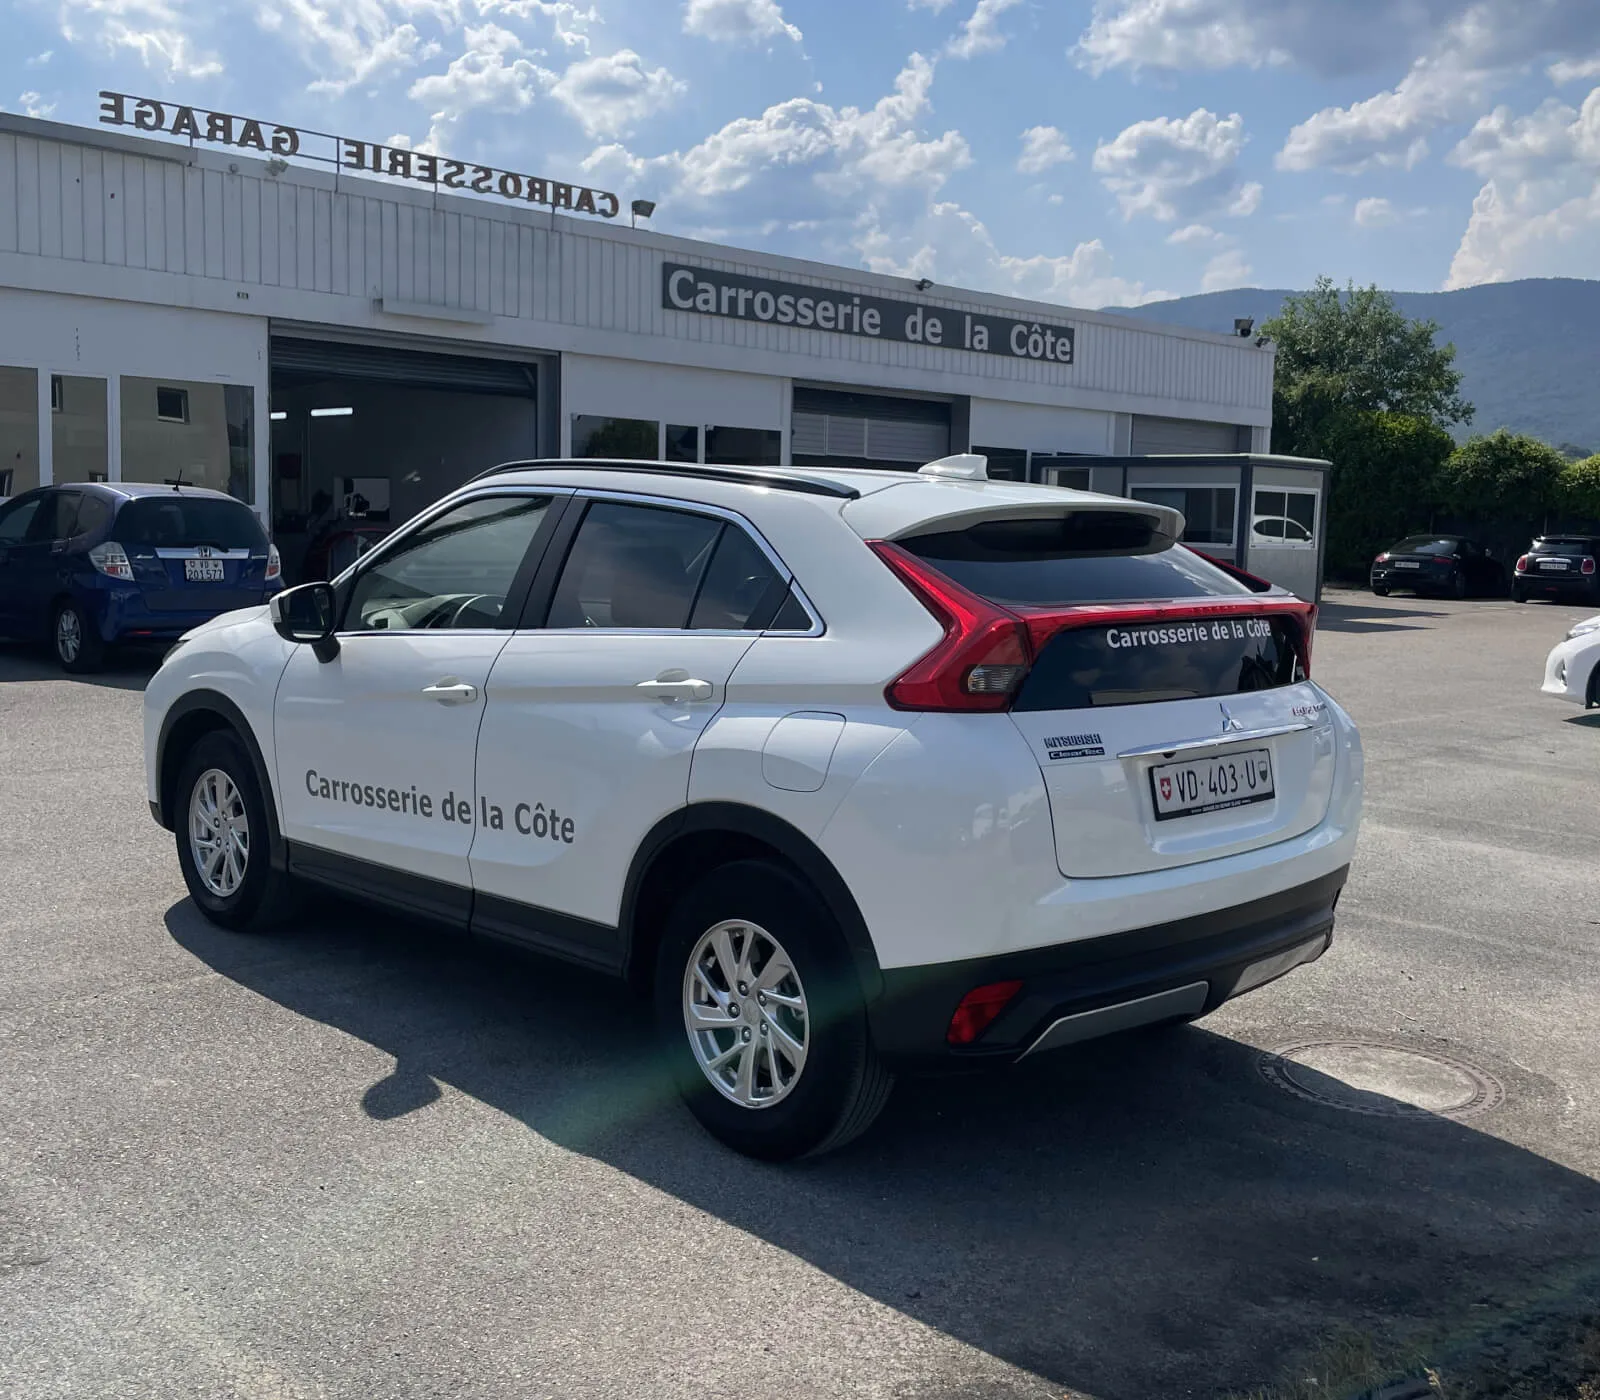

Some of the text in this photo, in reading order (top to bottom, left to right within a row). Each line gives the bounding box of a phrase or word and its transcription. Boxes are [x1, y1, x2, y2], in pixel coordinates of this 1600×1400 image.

[668, 269, 1071, 362] Carrosserie de la Côte
[1106, 618, 1272, 648] Carrosserie de la Côte
[1043, 733, 1103, 749] MITSUBISHI
[305, 769, 575, 843] Carrosserie de la Côte
